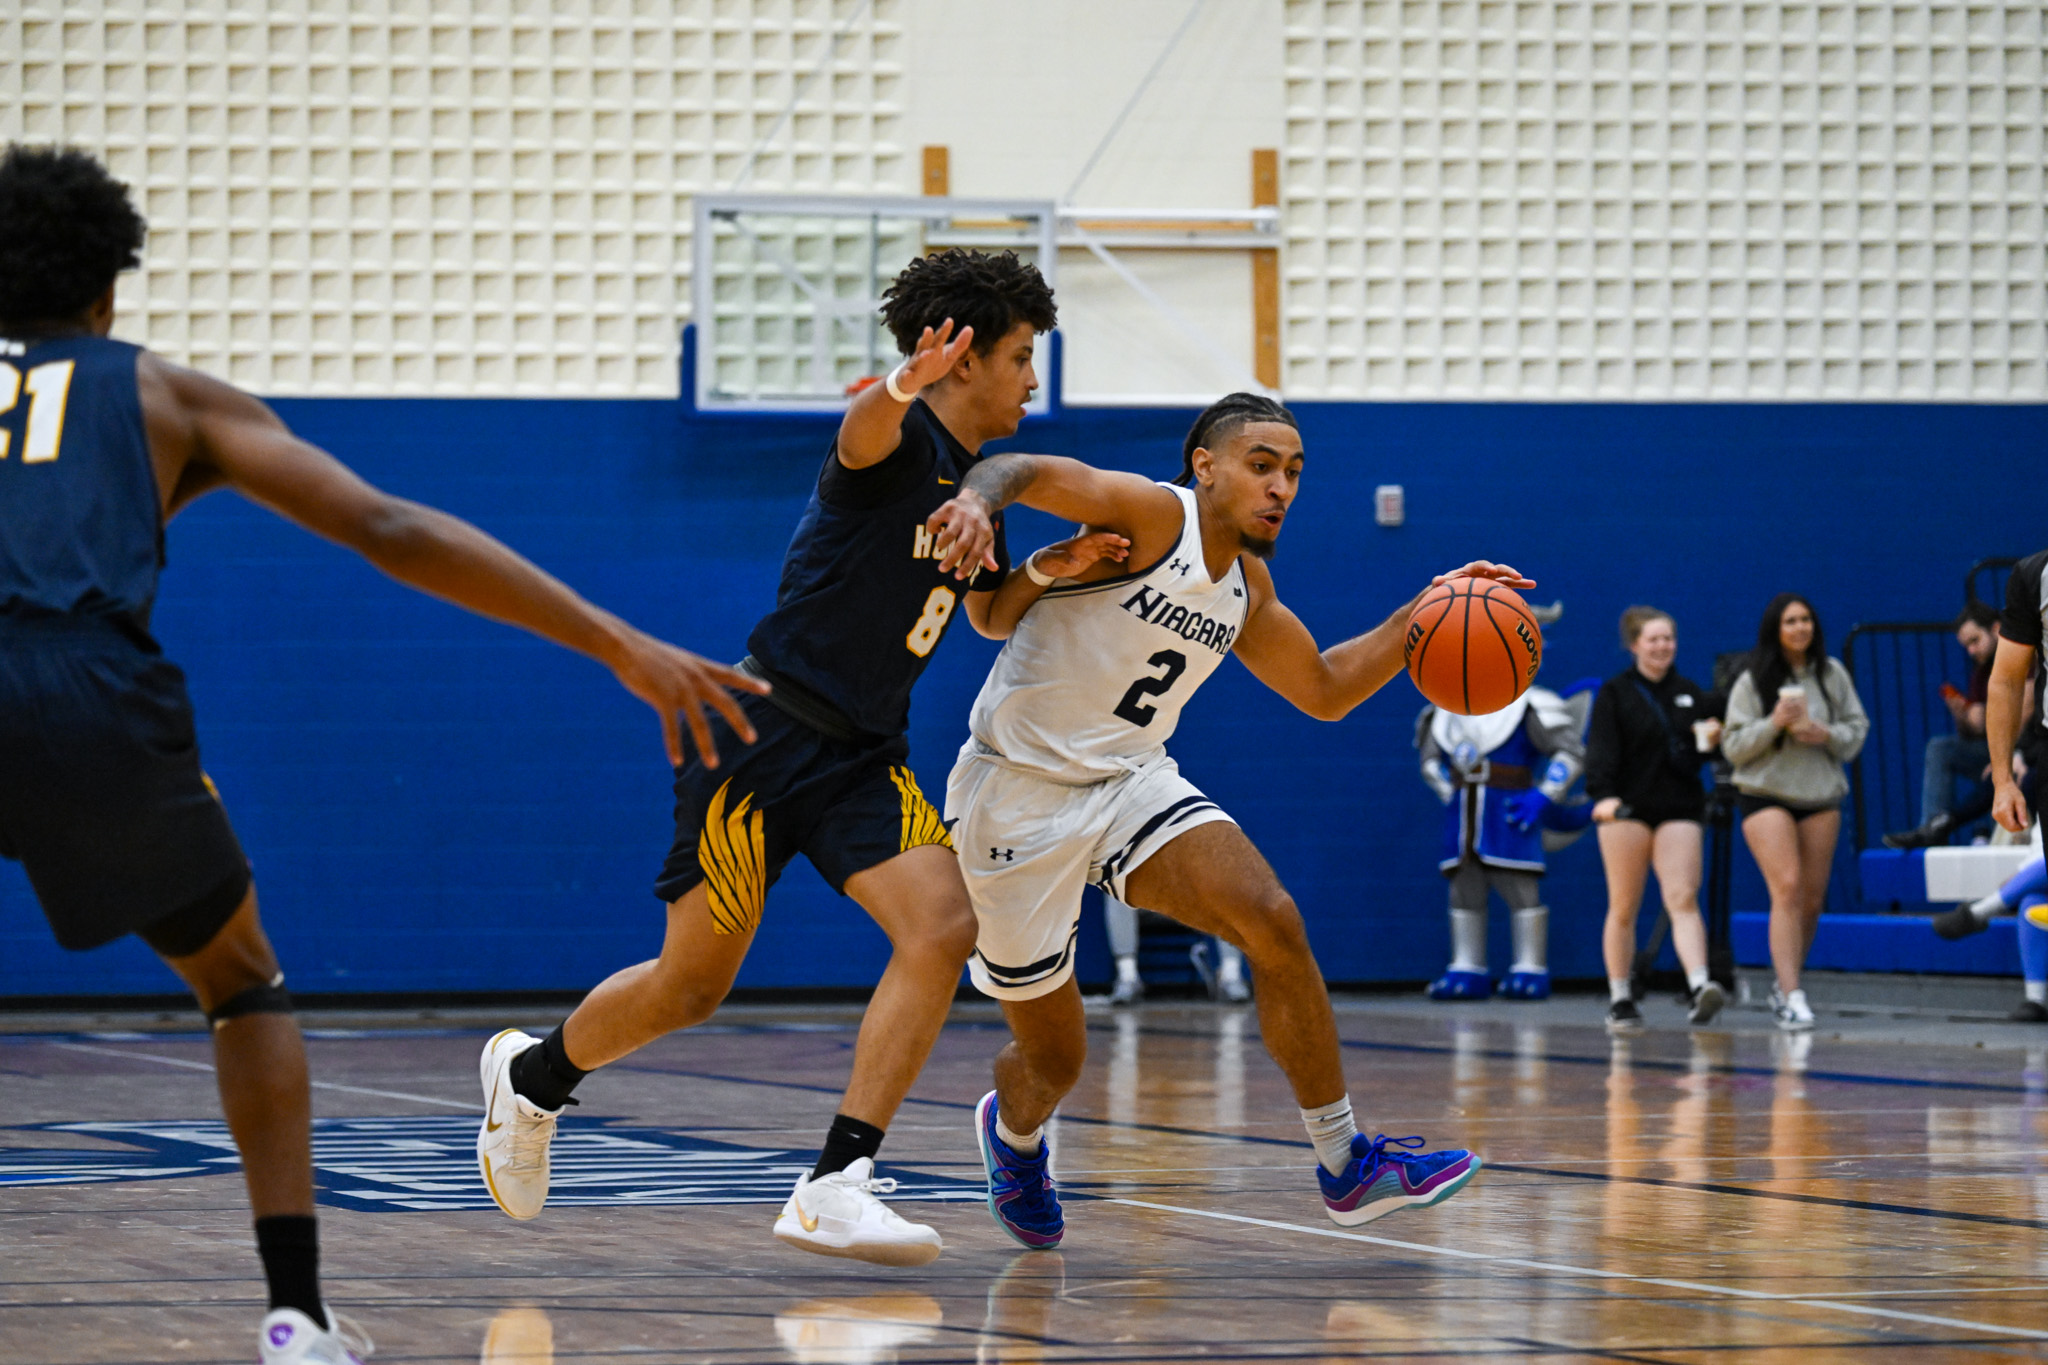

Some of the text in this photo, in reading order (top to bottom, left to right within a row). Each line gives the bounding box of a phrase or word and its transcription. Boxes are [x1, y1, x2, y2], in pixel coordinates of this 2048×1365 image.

[906, 585, 956, 658] 8
[1119, 584, 1236, 656] NIAGARA
[1113, 649, 1187, 728] 2
